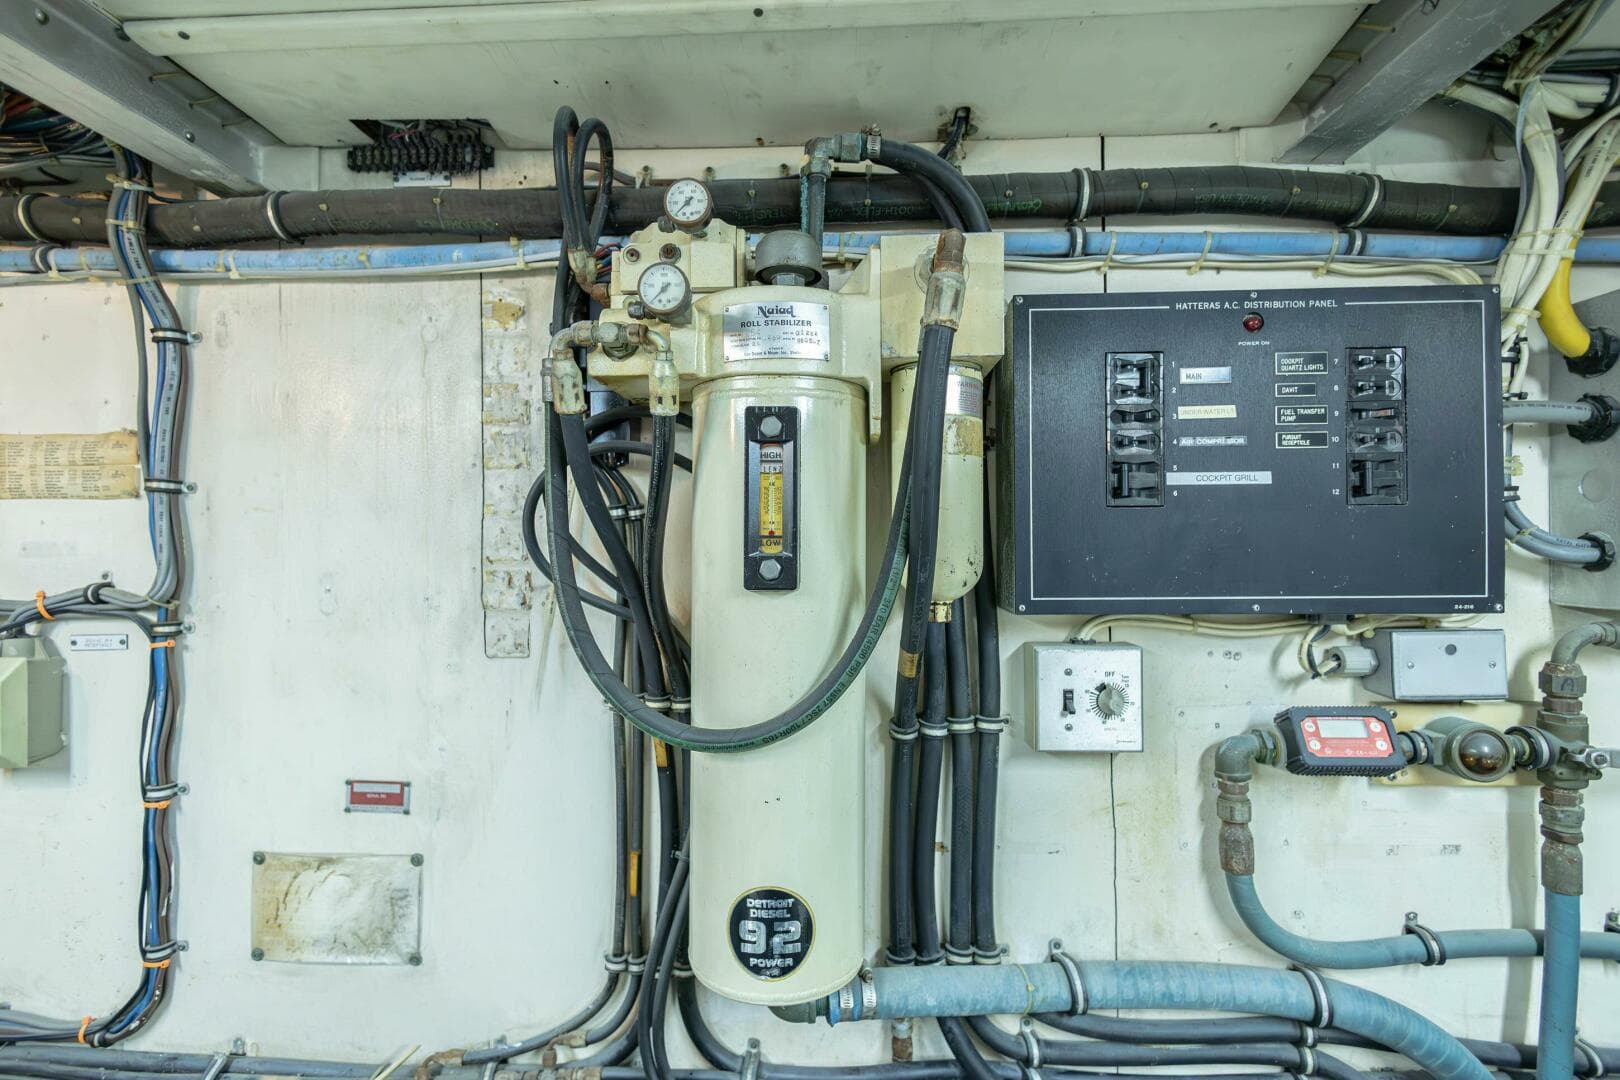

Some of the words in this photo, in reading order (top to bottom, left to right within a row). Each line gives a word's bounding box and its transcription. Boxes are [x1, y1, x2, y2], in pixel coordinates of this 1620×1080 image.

[1175, 302, 1221, 310] HATTERAS
[1223, 301, 1240, 309] A.C.
[1244, 300, 1306, 309] DISTRIBUTION
[1309, 299, 1338, 308] PANEL
[757, 305, 796, 318] Naiad
[741, 321, 761, 329] ROLL
[764, 319, 812, 327] STABILIZER
[1185, 372, 1202, 380] MAIN
[761, 451, 782, 459] HIGH
[1196, 474, 1232, 482] COCKPIT
[880, 597, 891, 615] 310
[869, 614, 885, 637] BAR
[857, 635, 874, 660] (4500
[845, 658, 862, 678] PSI)
[746, 898, 795, 909] DETROIT
[750, 908, 791, 918] DIESEL
[739, 920, 802, 955] 92
[749, 957, 793, 967] POWER
